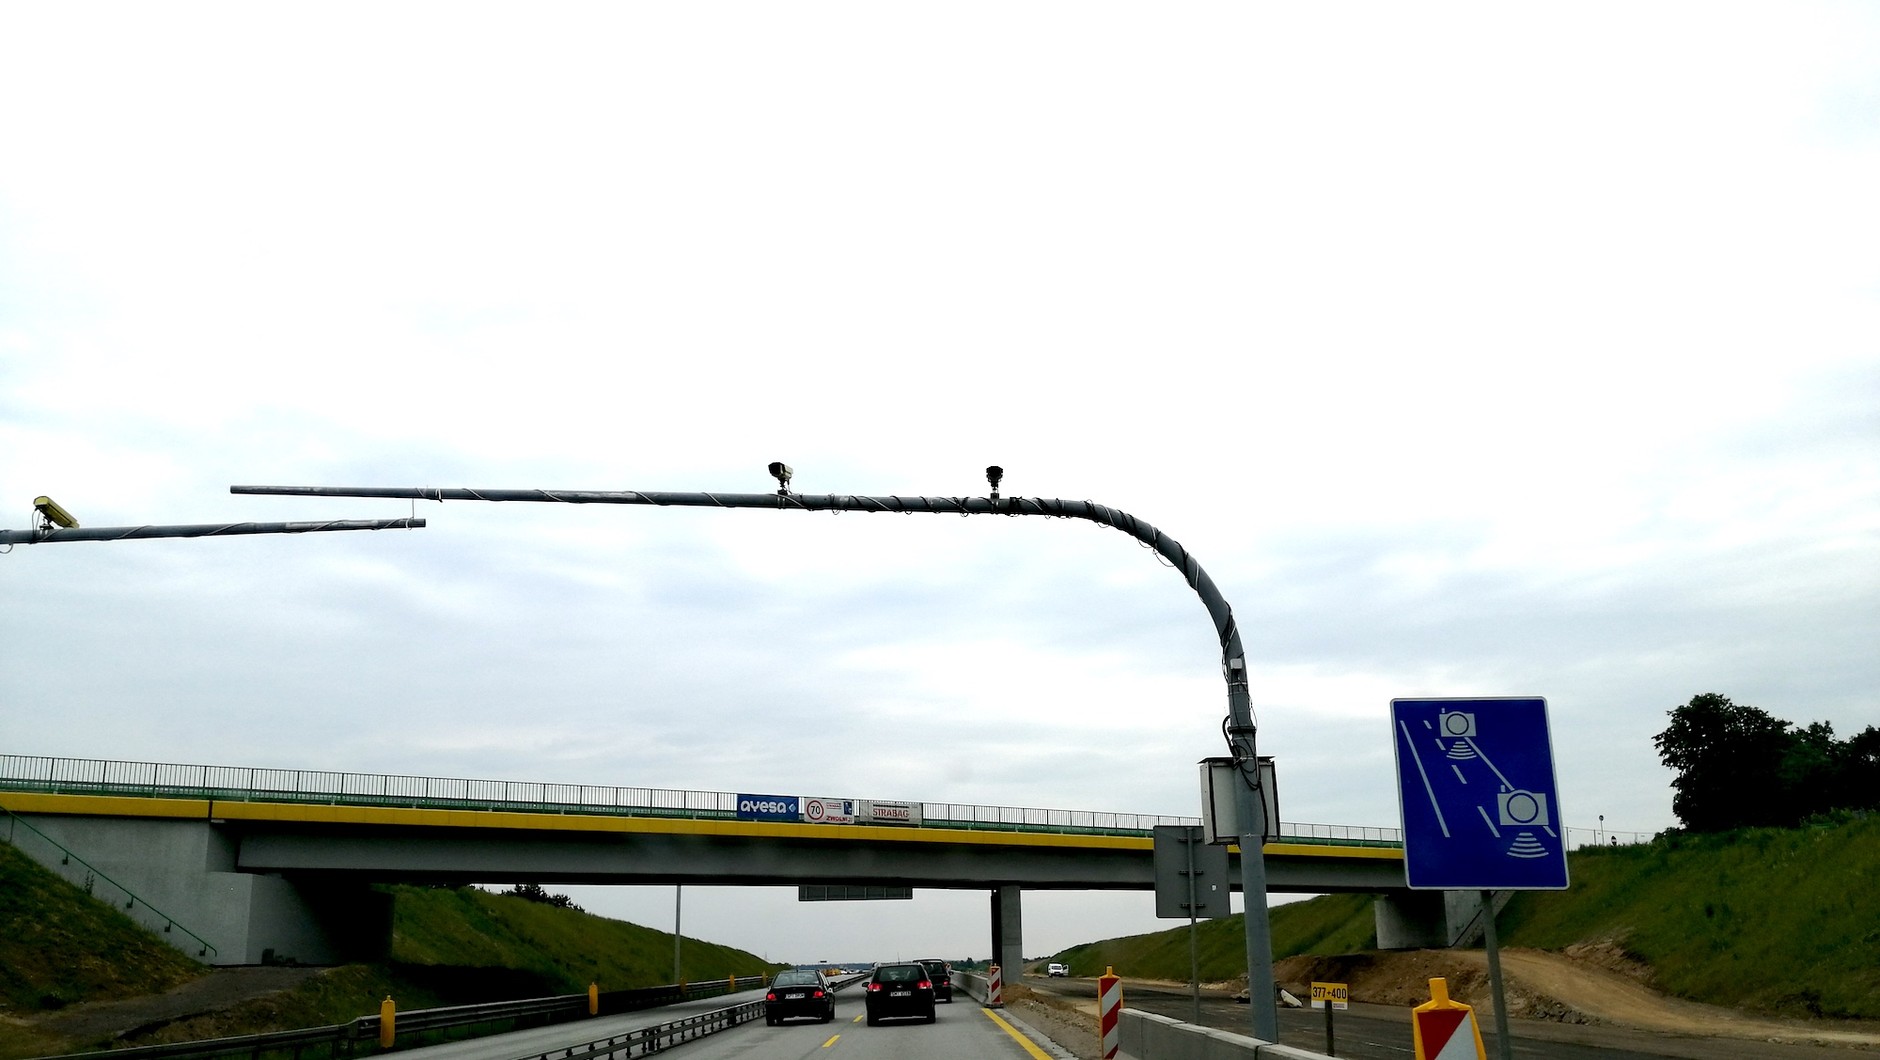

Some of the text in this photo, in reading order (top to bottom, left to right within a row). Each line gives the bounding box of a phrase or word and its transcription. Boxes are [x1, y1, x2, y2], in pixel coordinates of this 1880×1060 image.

[740, 800, 787, 814] ayesa
[811, 805, 821, 815] 70
[872, 808, 910, 818] STRABAG
[1312, 986, 1347, 999] 377+400
